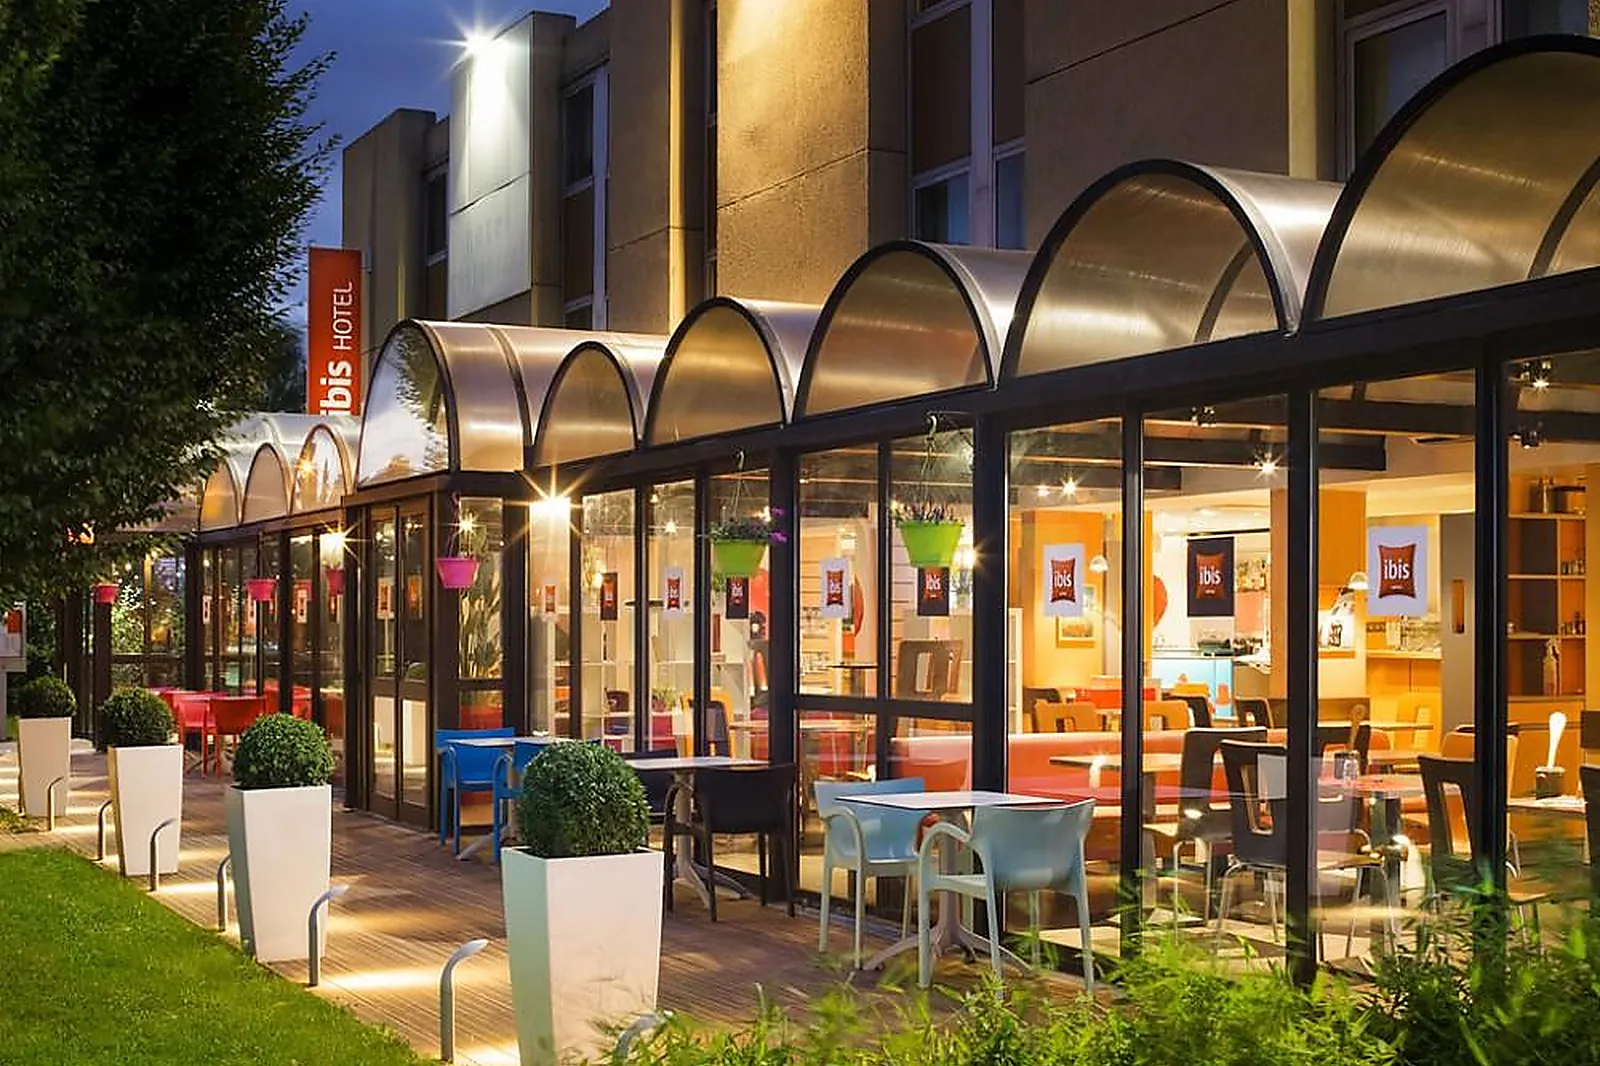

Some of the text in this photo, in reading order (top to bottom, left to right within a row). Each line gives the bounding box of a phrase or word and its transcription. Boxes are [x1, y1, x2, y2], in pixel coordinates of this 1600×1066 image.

[320, 281, 352, 416] ibis HOTEL
[1054, 570, 1072, 587] ibis
[1200, 565, 1221, 585] ibis
[1384, 559, 1409, 580] ibis
[925, 574, 941, 590] ibis
